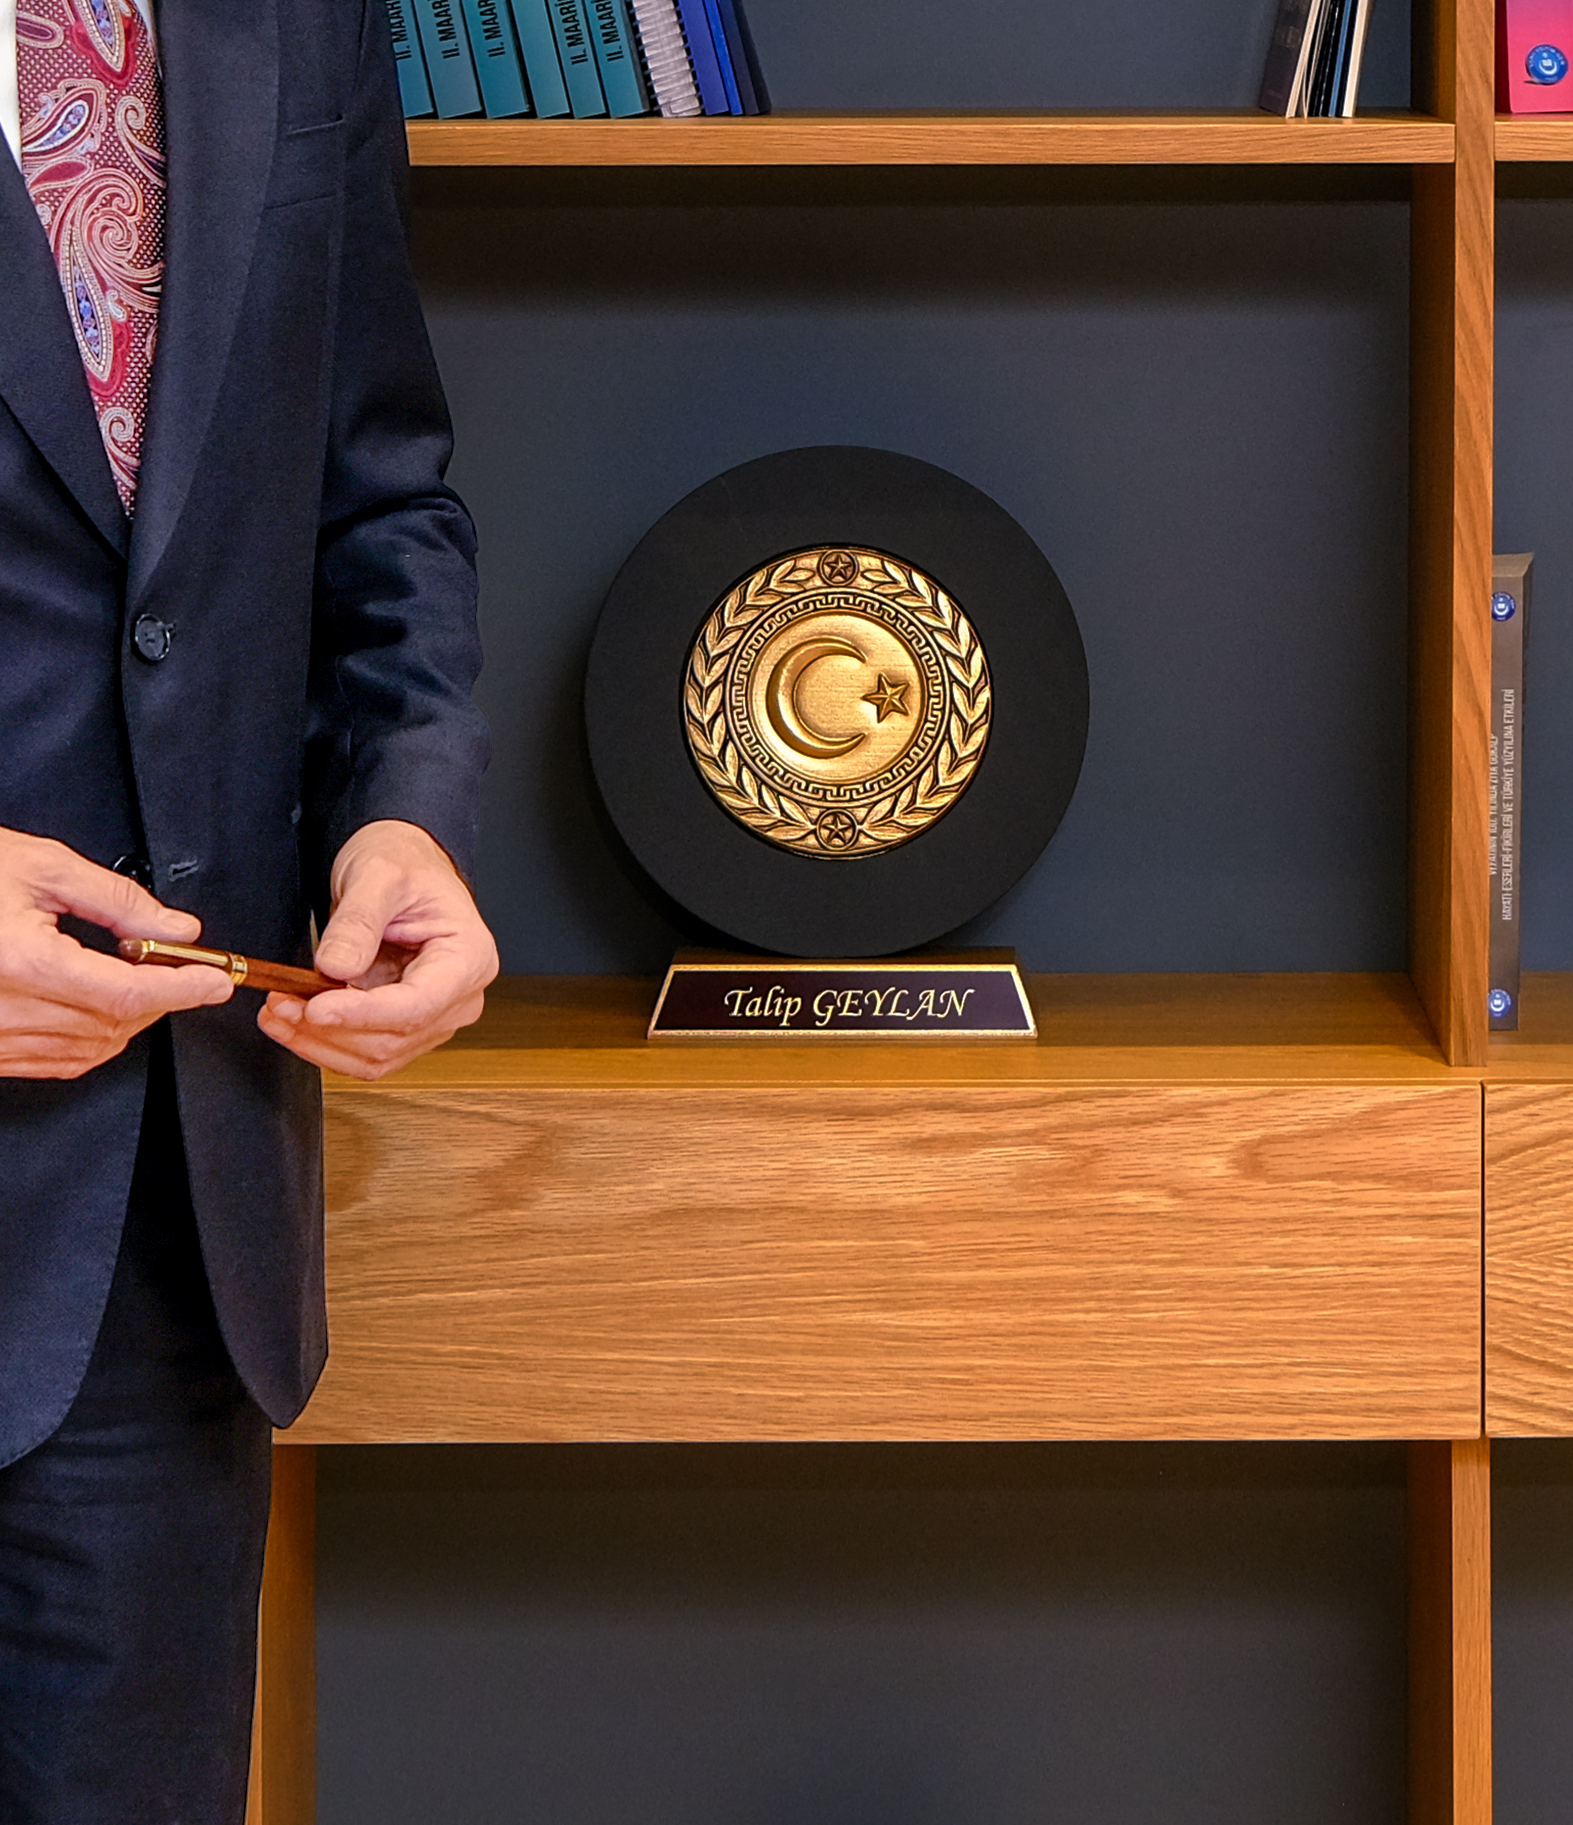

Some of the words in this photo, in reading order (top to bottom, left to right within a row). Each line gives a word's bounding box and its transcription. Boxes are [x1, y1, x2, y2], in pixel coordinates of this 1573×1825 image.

[487, 42, 505, 57] II.
[724, 985, 802, 1027] Talip
[813, 986, 976, 1027] GEYLAN
